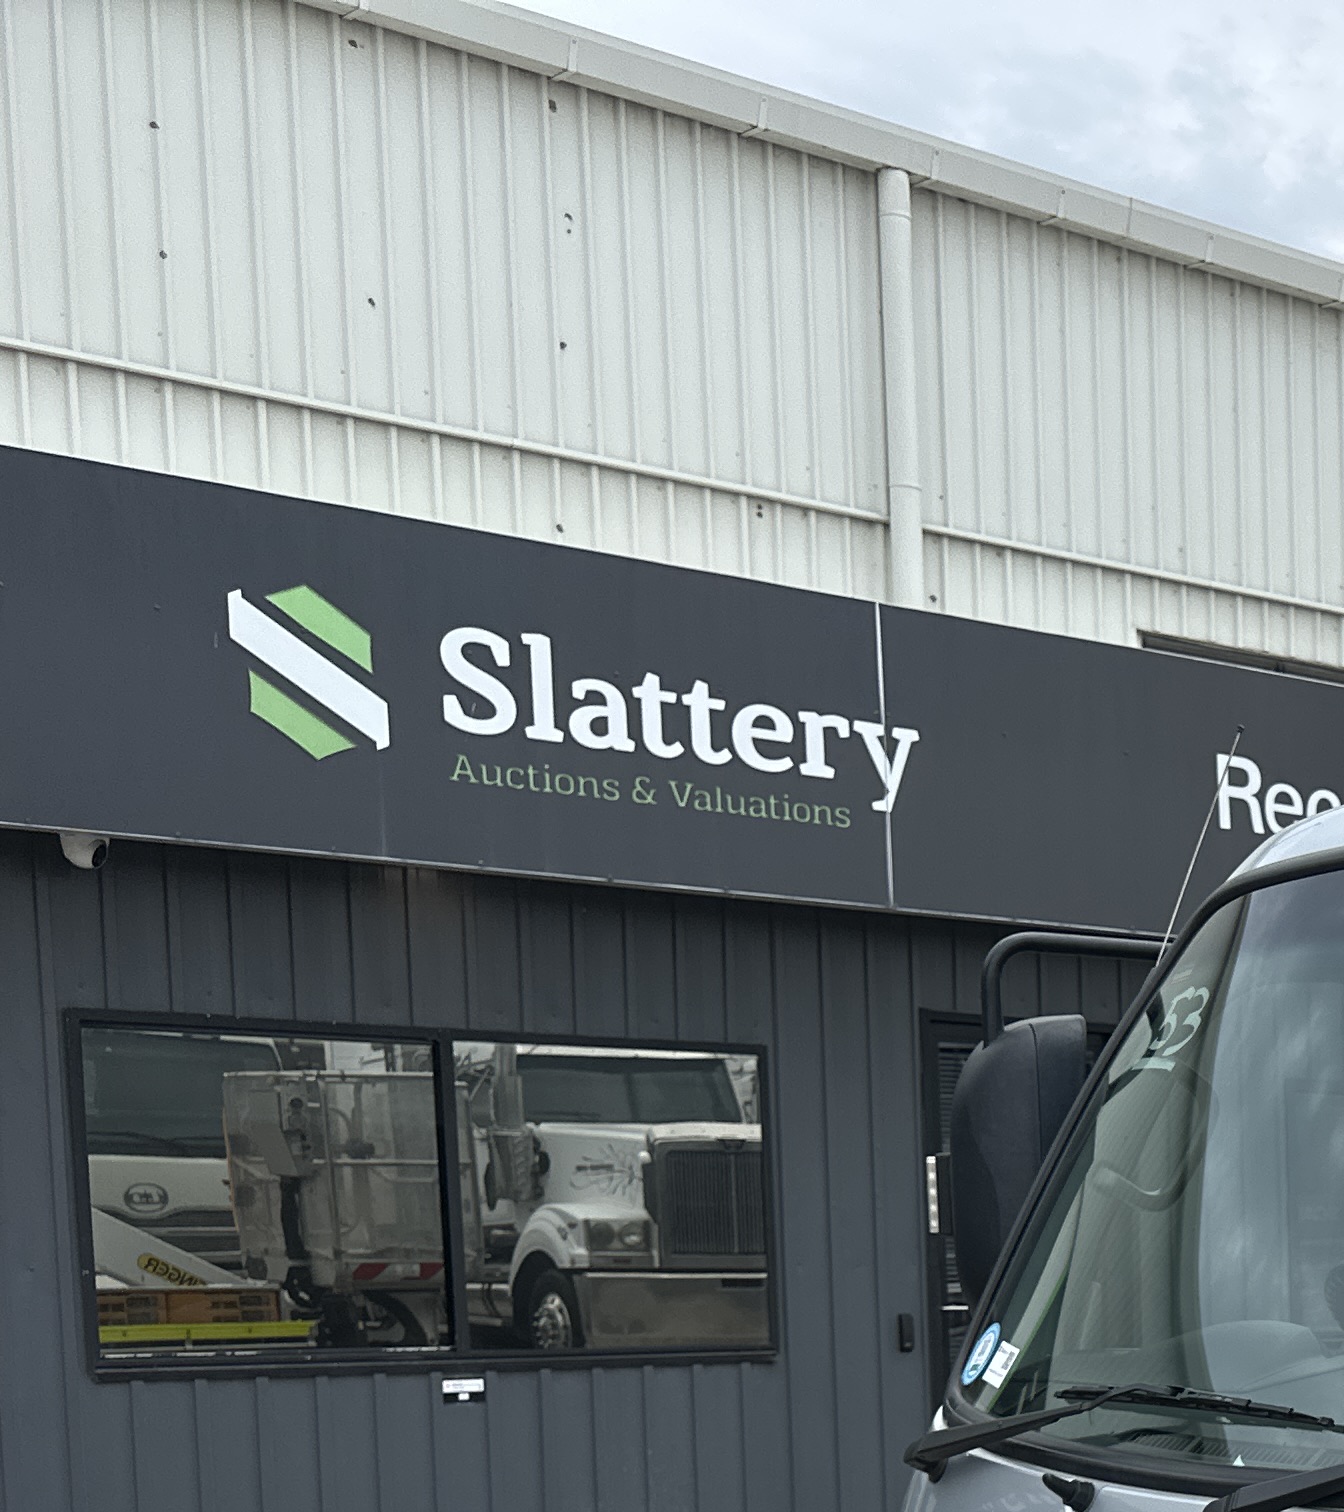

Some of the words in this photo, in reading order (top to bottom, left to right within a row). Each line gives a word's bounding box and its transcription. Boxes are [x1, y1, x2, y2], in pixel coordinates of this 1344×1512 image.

[439, 626, 920, 813] Slattery
[449, 753, 621, 802] Auctions
[631, 775, 658, 805] &
[667, 779, 852, 829] Valuations
